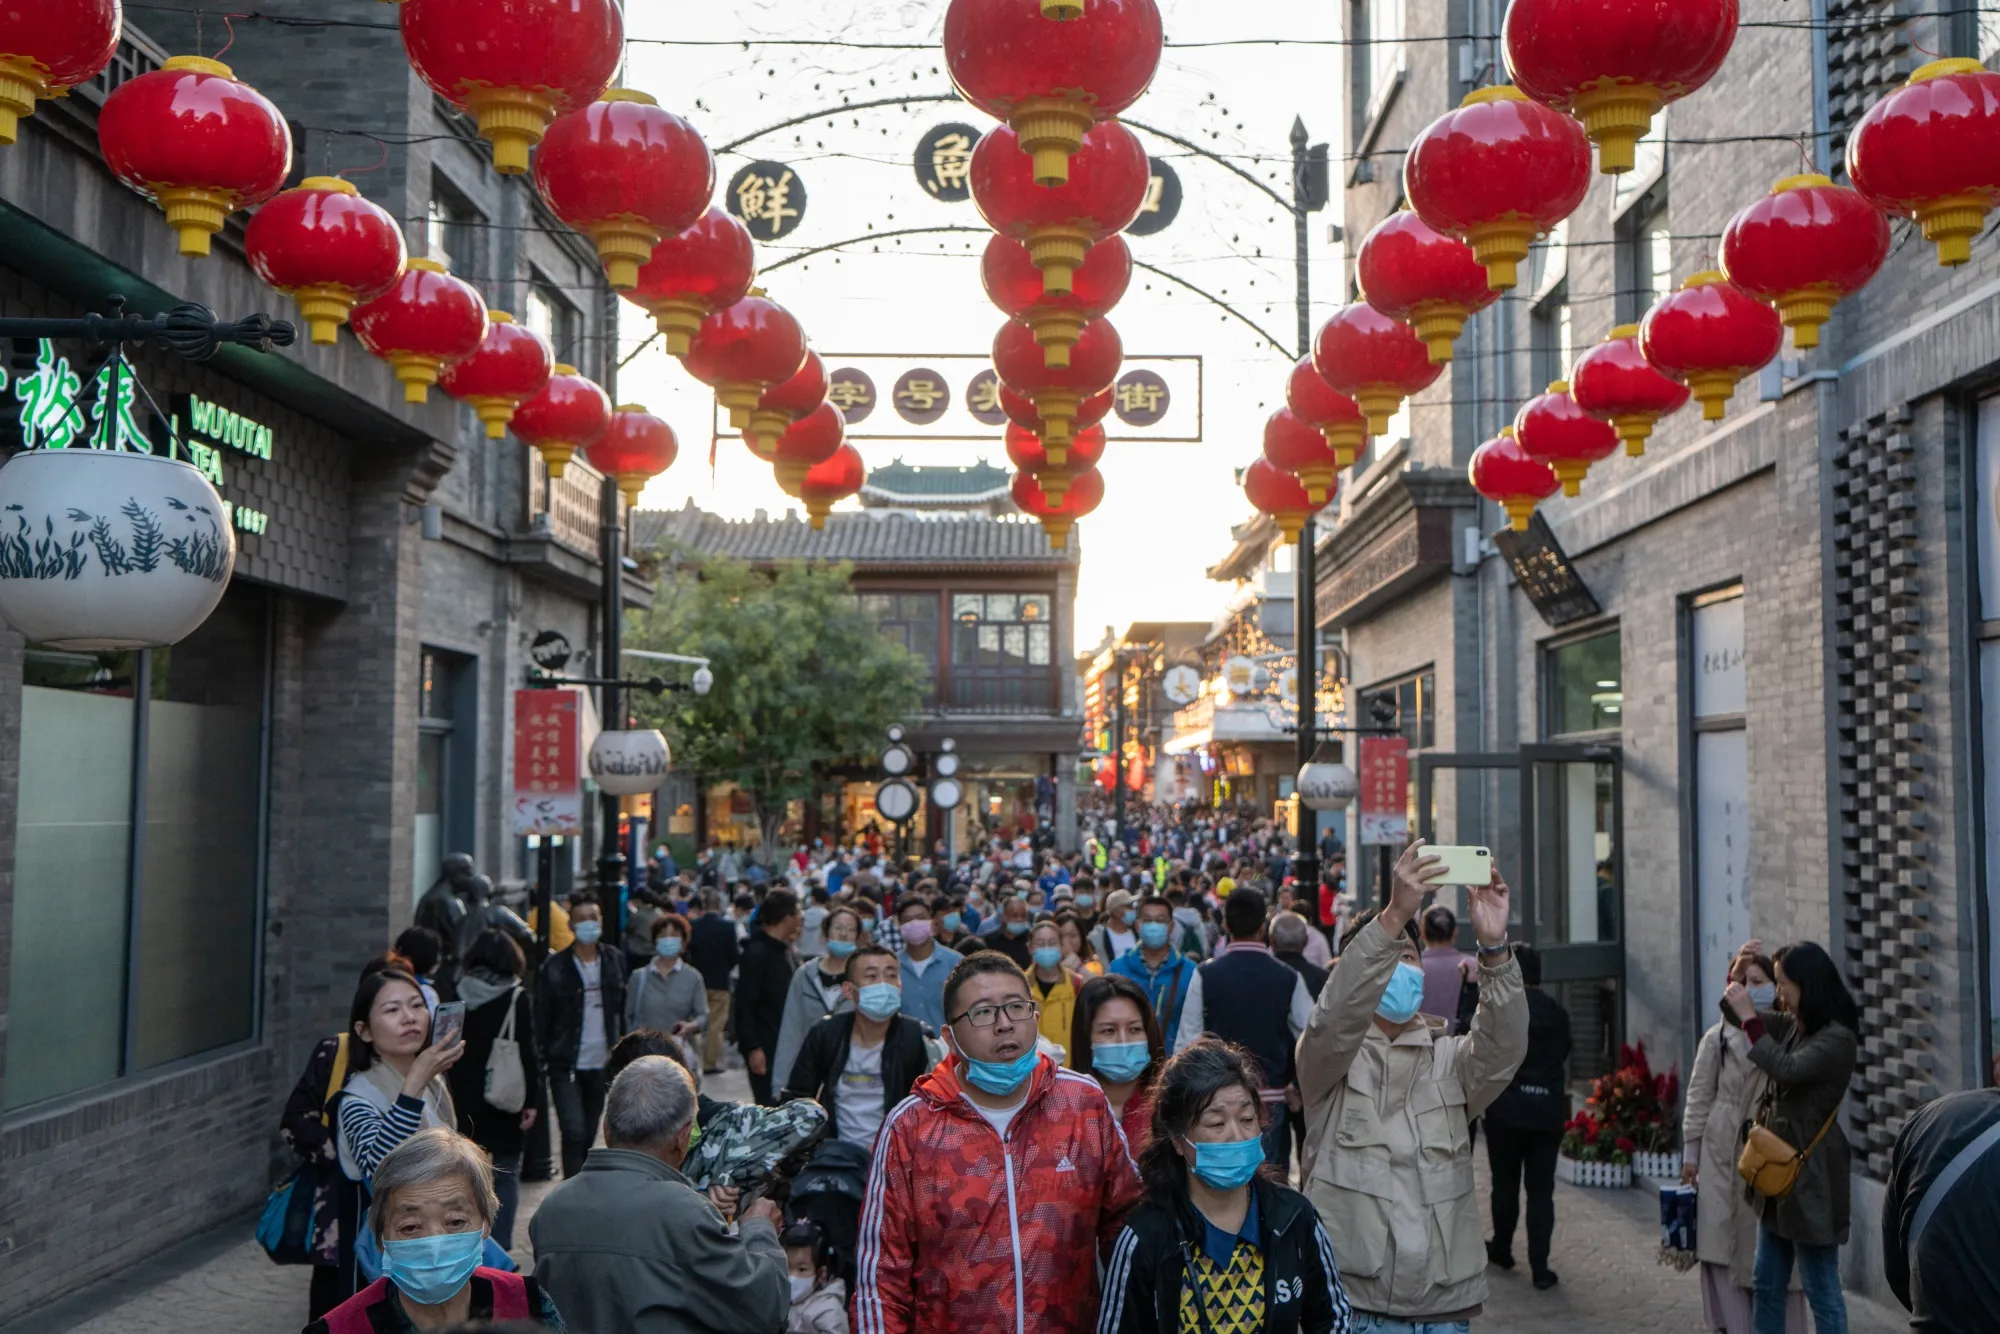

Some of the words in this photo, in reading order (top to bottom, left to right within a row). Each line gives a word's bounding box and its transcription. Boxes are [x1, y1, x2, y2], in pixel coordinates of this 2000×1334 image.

[0, 338, 152, 454] 裕泰
[190, 393, 273, 461] WUYUTAI
[188, 439, 224, 486] TEA
